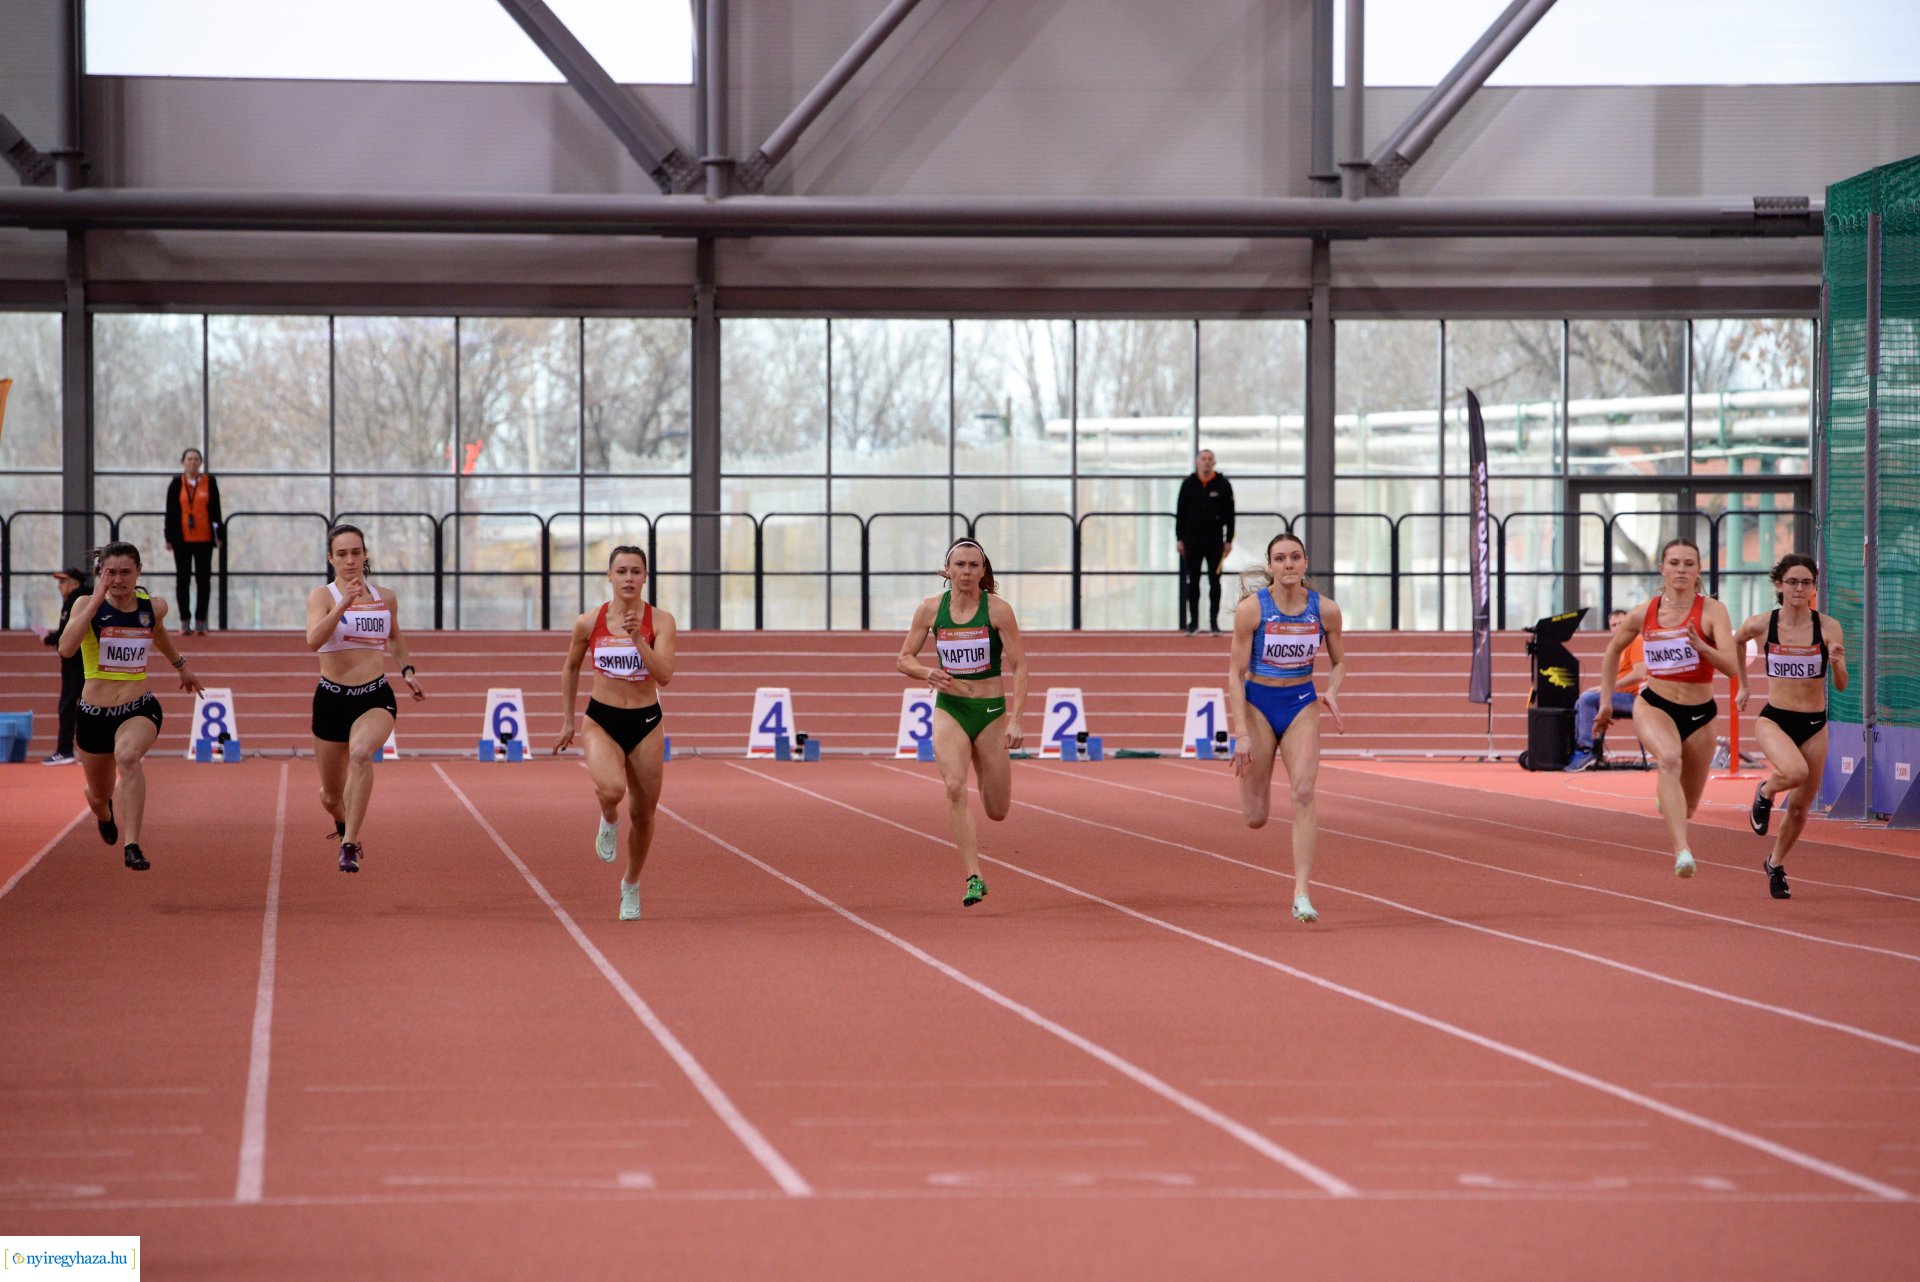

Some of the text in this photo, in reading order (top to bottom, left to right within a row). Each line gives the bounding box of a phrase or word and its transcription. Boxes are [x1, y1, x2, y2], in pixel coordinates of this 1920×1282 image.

[355, 617, 384, 633] FODOR
[107, 645, 137, 662] NAGY
[942, 647, 985, 664] KAPTUR
[1266, 643, 1305, 658] KOCSIS
[1645, 646, 1696, 663] TAKÁCS B.
[1774, 662, 1817, 677] SIPOS B.
[346, 682, 377, 696] NIKE
[106, 698, 140, 717] NIKE
[201, 701, 228, 742] 8
[492, 701, 519, 742] 6
[758, 701, 788, 737] 4
[908, 701, 933, 741] 3
[1052, 701, 1078, 741] 2
[1196, 700, 1214, 740] 1
